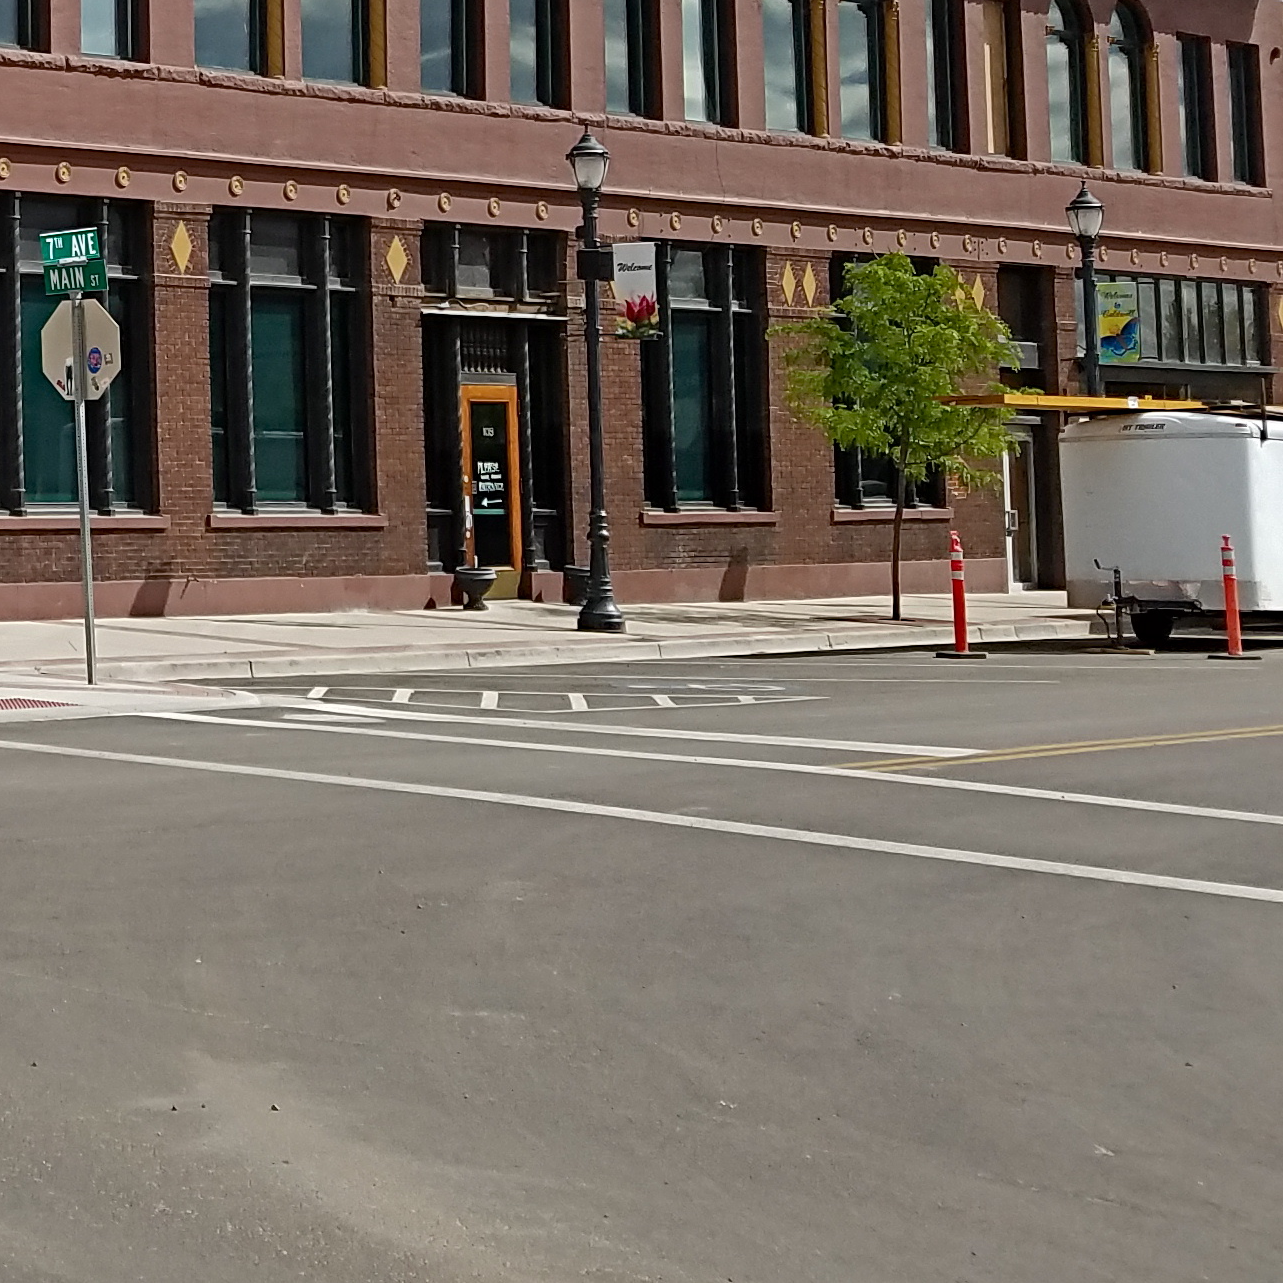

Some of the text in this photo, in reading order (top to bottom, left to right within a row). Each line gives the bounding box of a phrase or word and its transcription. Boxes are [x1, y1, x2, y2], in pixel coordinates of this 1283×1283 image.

[45, 232, 97, 260] 7TH AVE
[49, 266, 100, 291] MAIN ST
[617, 262, 653, 272] Welcome
